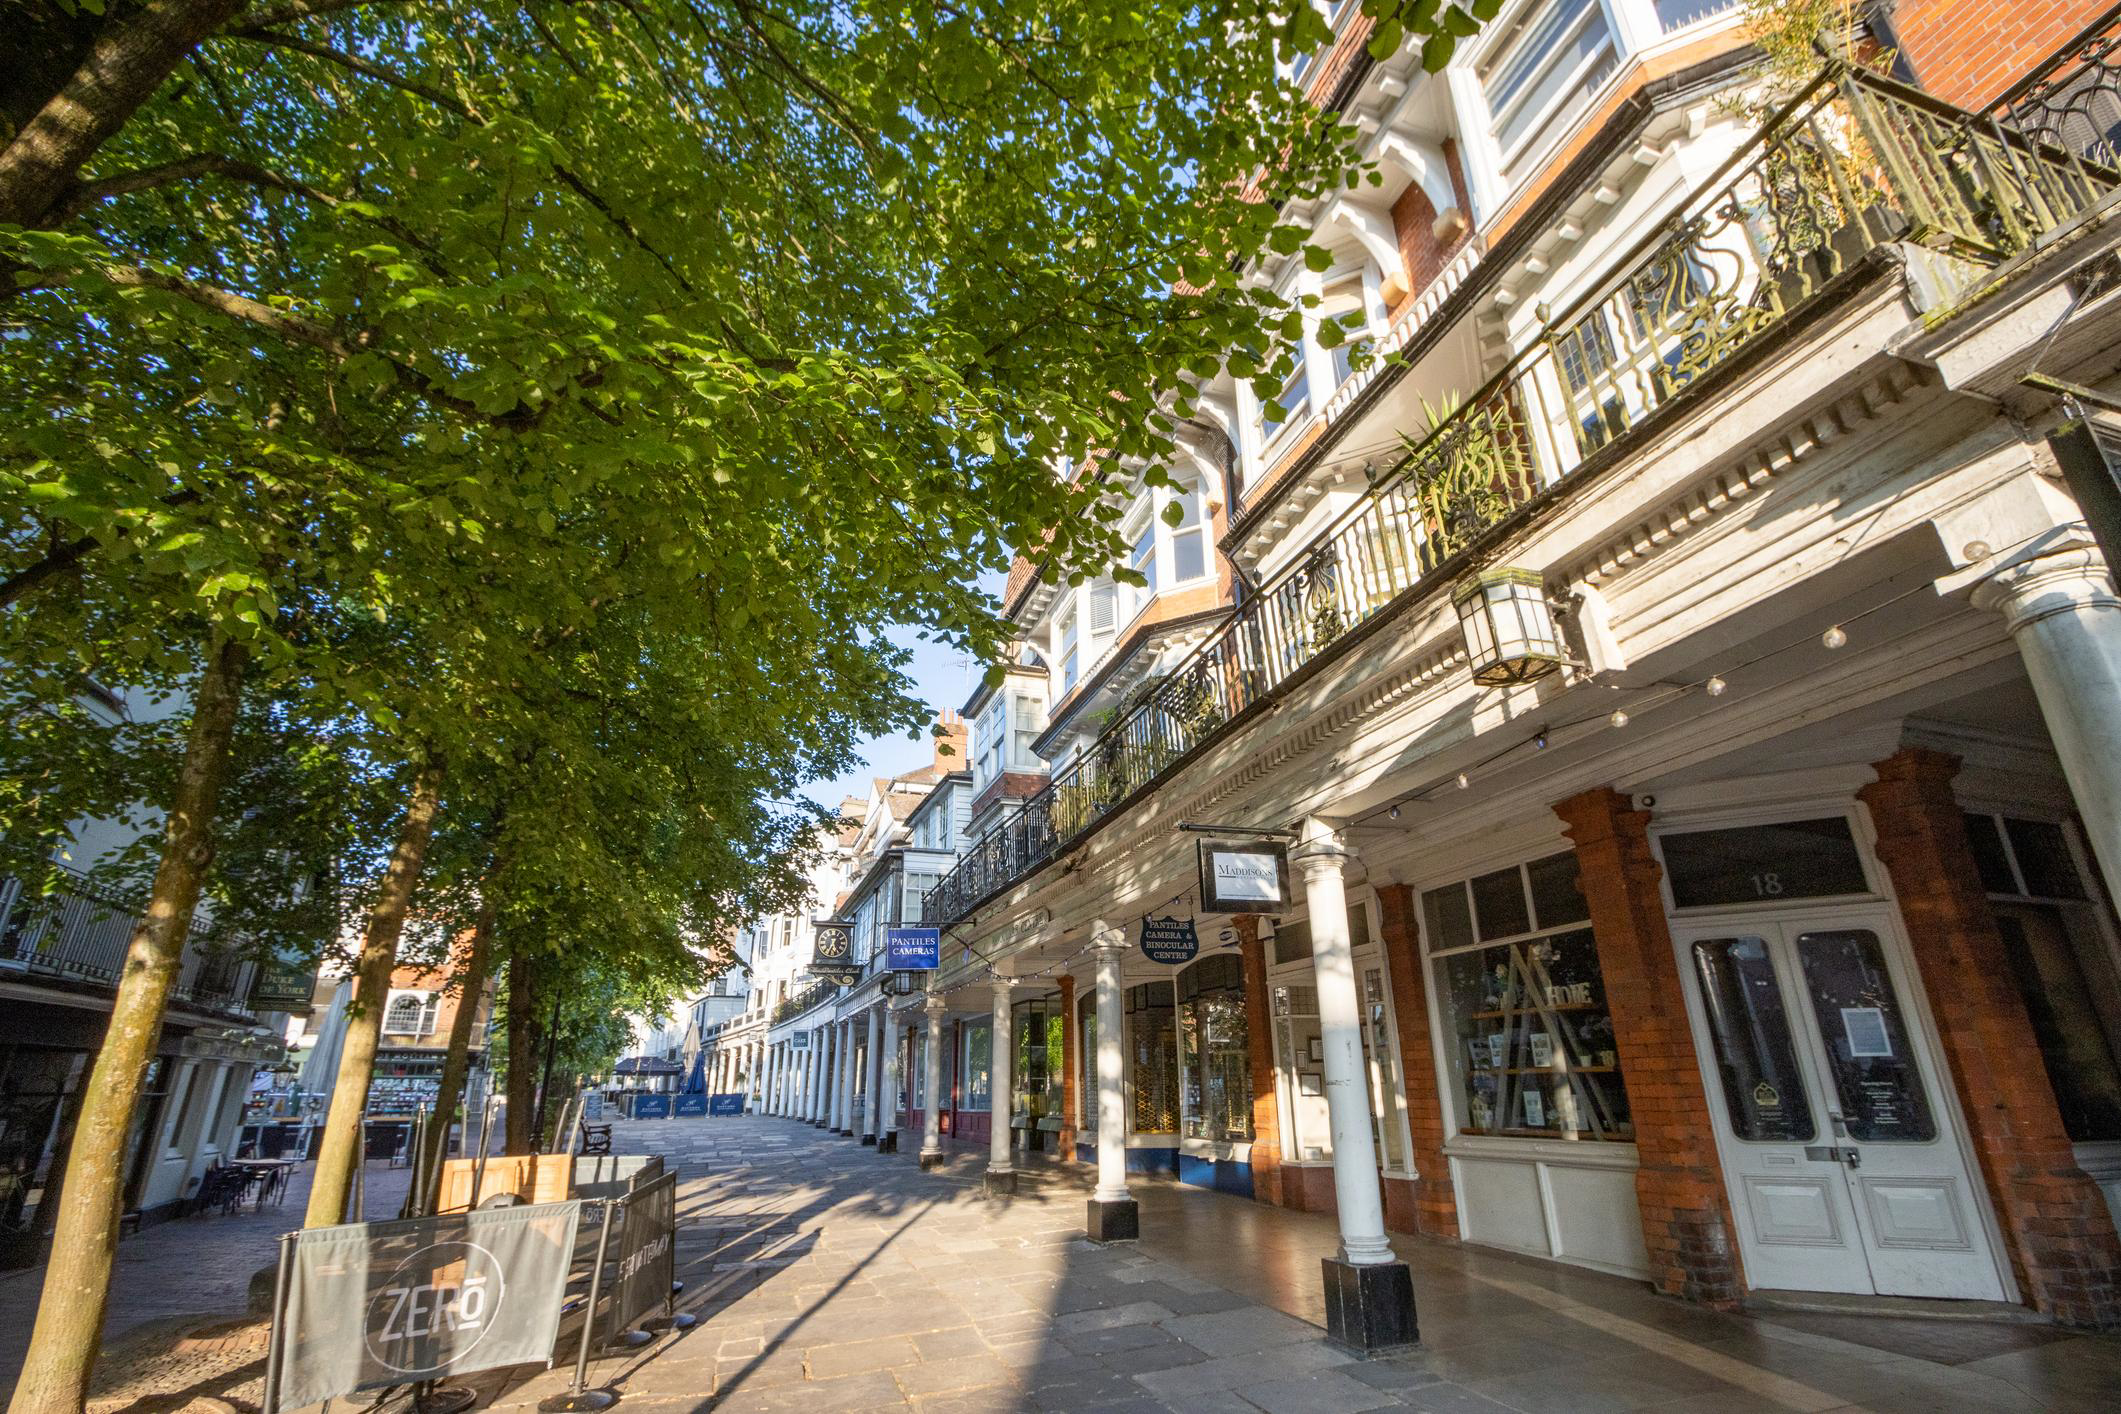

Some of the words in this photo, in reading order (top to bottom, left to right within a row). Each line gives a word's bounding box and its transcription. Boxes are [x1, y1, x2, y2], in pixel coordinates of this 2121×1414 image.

[1751, 872, 1783, 896] 18
[1150, 921, 1190, 929] PANTILES
[1146, 931, 1182, 939] CAMERA
[892, 938, 935, 946] PANTILES
[1153, 951, 1188, 959] CENTRE
[1545, 982, 1593, 1004] HOME
